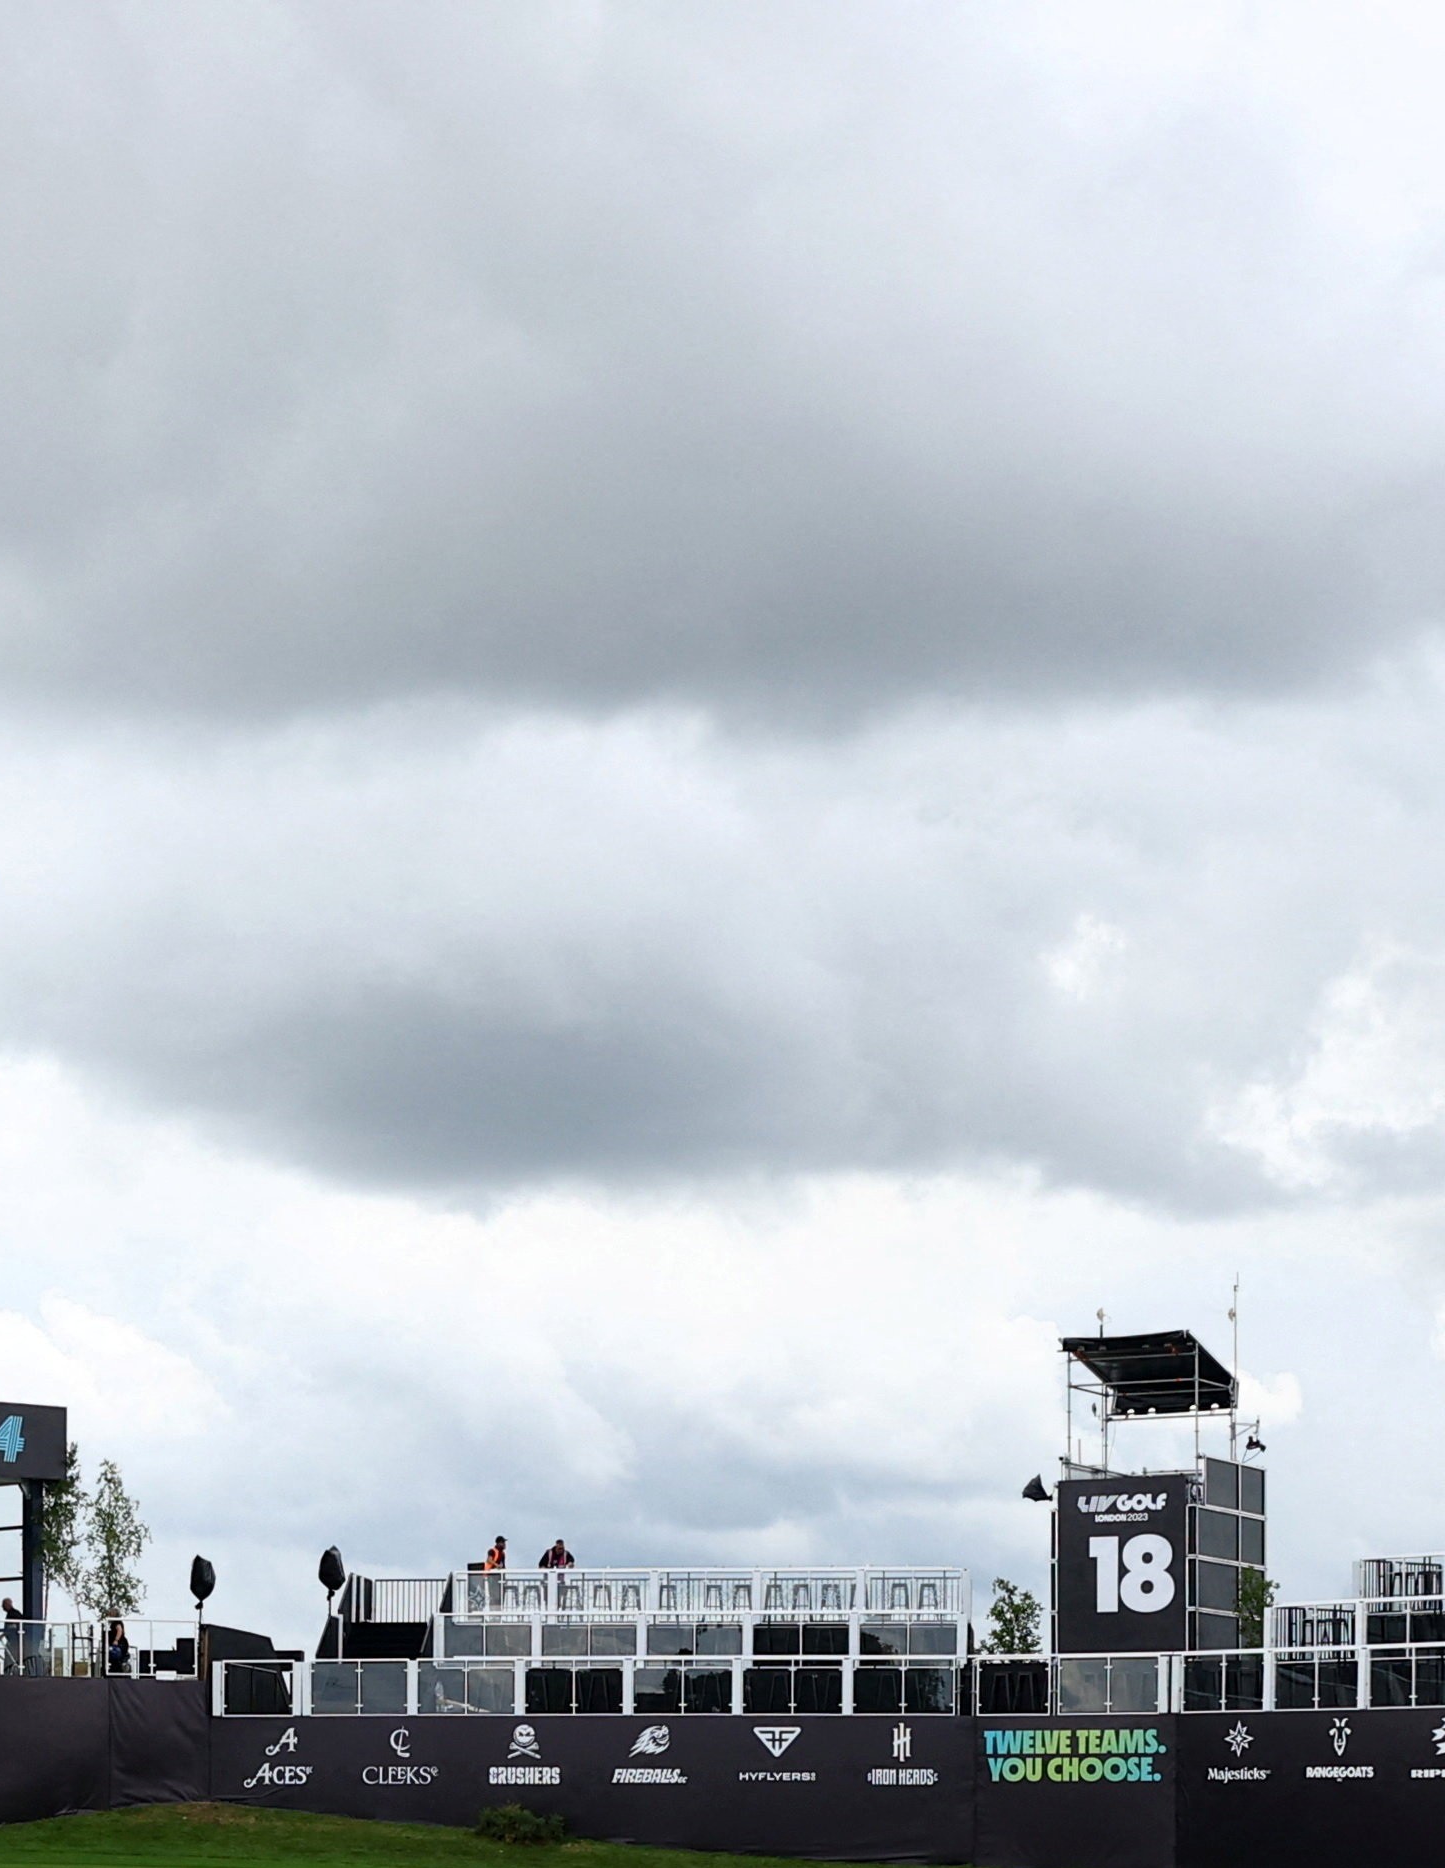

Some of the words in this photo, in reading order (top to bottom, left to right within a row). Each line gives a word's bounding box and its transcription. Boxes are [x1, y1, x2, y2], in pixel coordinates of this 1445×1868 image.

[1077, 1494, 1119, 1513] LIV
[1116, 1492, 1167, 1512] GOLF
[1095, 1513, 1126, 1522] LONDON
[1126, 1513, 1148, 1521] 2023
[1089, 1533, 1175, 1613] 18
[983, 1730, 1072, 1754] TWELVE
[1076, 1729, 1167, 1754] TEAMS.
[362, 1766, 432, 1785] CLEEKS
[489, 1767, 561, 1785] CRUSHERS
[611, 1768, 681, 1784] FIREBALLS
[739, 1772, 811, 1781] HYFLYERS
[872, 1768, 897, 1785] IRON
[987, 1757, 1043, 1782] YOU
[1047, 1756, 1162, 1782] CHOOSE.
[1207, 1767, 1267, 1784] Majesticks
[1305, 1766, 1374, 1778] RANGEGOATS
